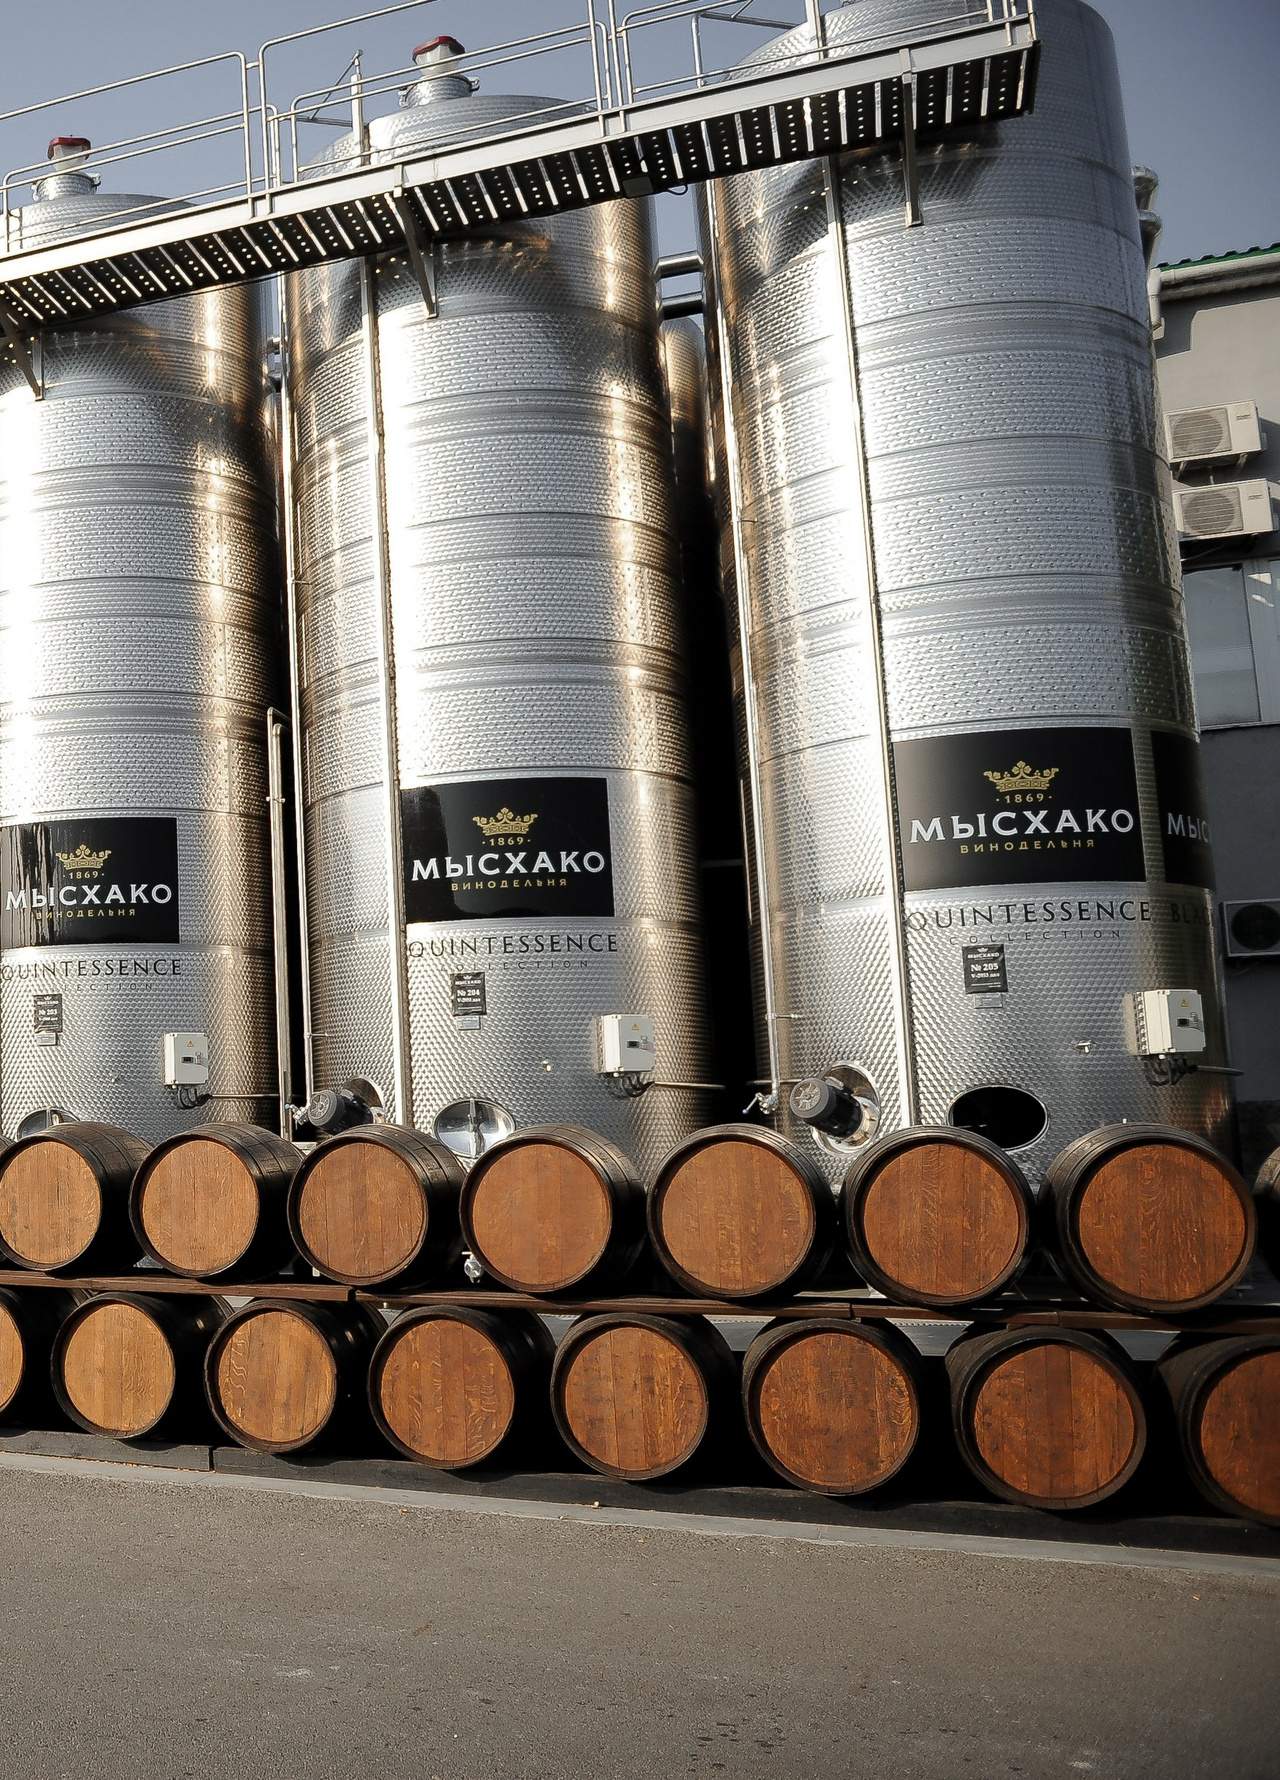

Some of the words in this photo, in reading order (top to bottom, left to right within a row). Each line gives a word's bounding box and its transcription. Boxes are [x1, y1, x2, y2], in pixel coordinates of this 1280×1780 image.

[1004, 793, 1045, 804] 1869
[909, 809, 1134, 844] МЫСХАКО
[1167, 812, 1212, 844] МЫС
[489, 836, 524, 846] 1869
[960, 839, 1094, 854] ВИНОДЕЛЬНЯ
[411, 851, 605, 881] МЫСХАКО
[68, 870, 99, 879] 1869
[451, 878, 567, 891] ВИНОДЕЛЬНЯ
[5, 883, 172, 911] МЫСХАКО
[36, 908, 136, 920] ВИНОДЕЛЬНЯ
[906, 900, 1151, 931] QUINTESSENCE
[949, 929, 1120, 945] COLLECTION
[408, 933, 619, 958] QUINTESSENCE
[0, 959, 182, 981] QUINTESSENCE
[982, 962, 999, 971] 205
